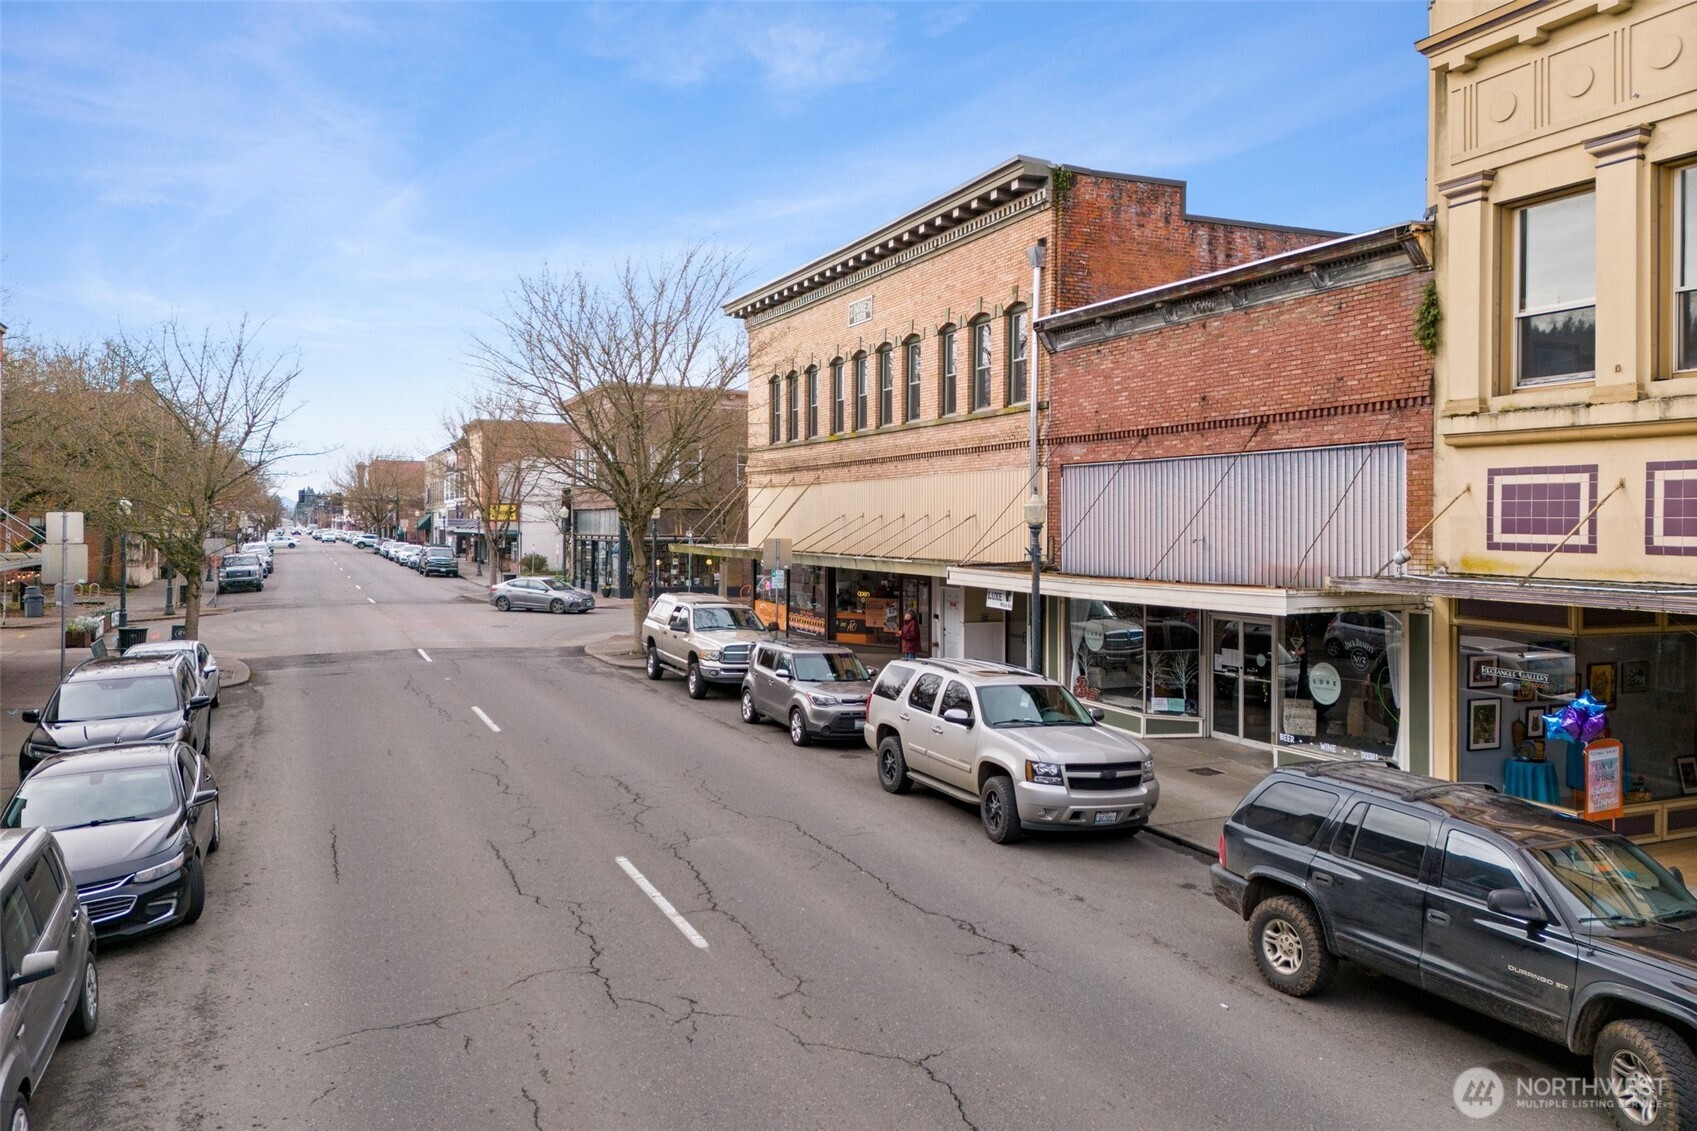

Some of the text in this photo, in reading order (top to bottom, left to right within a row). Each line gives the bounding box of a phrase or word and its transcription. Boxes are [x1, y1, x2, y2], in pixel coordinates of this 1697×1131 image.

[1280, 733, 1295, 744] BEER
[1320, 742, 1337, 753] WINE
[1507, 965, 1554, 986] DURANGO
